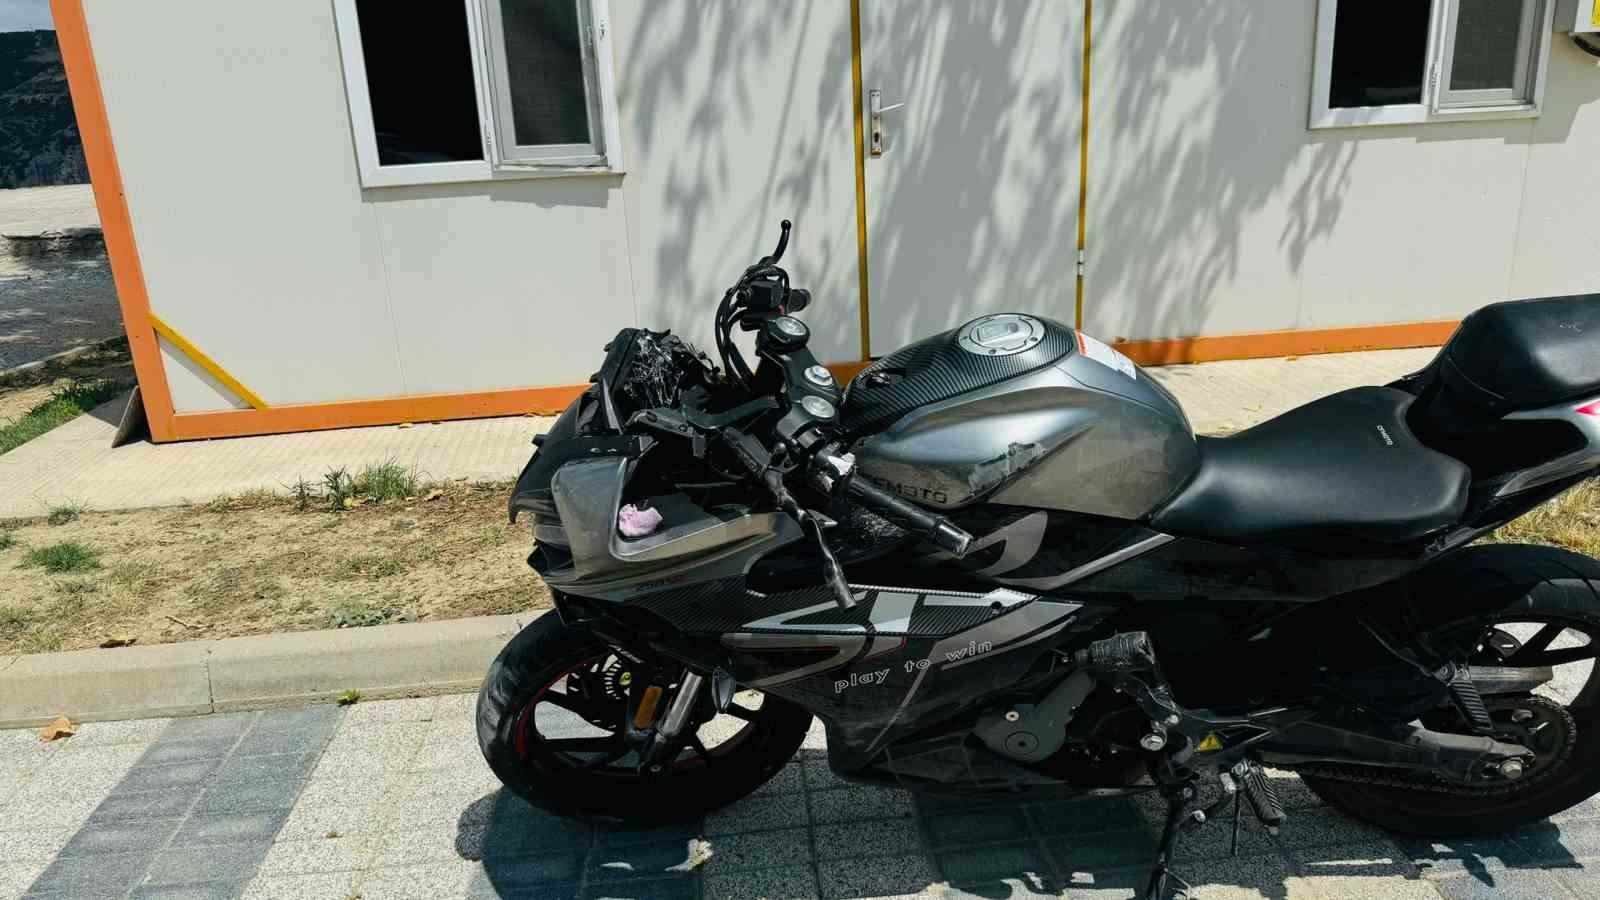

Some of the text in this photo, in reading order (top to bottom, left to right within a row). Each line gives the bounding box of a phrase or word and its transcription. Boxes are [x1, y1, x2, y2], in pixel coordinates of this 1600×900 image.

[834, 640, 993, 694] play to win
